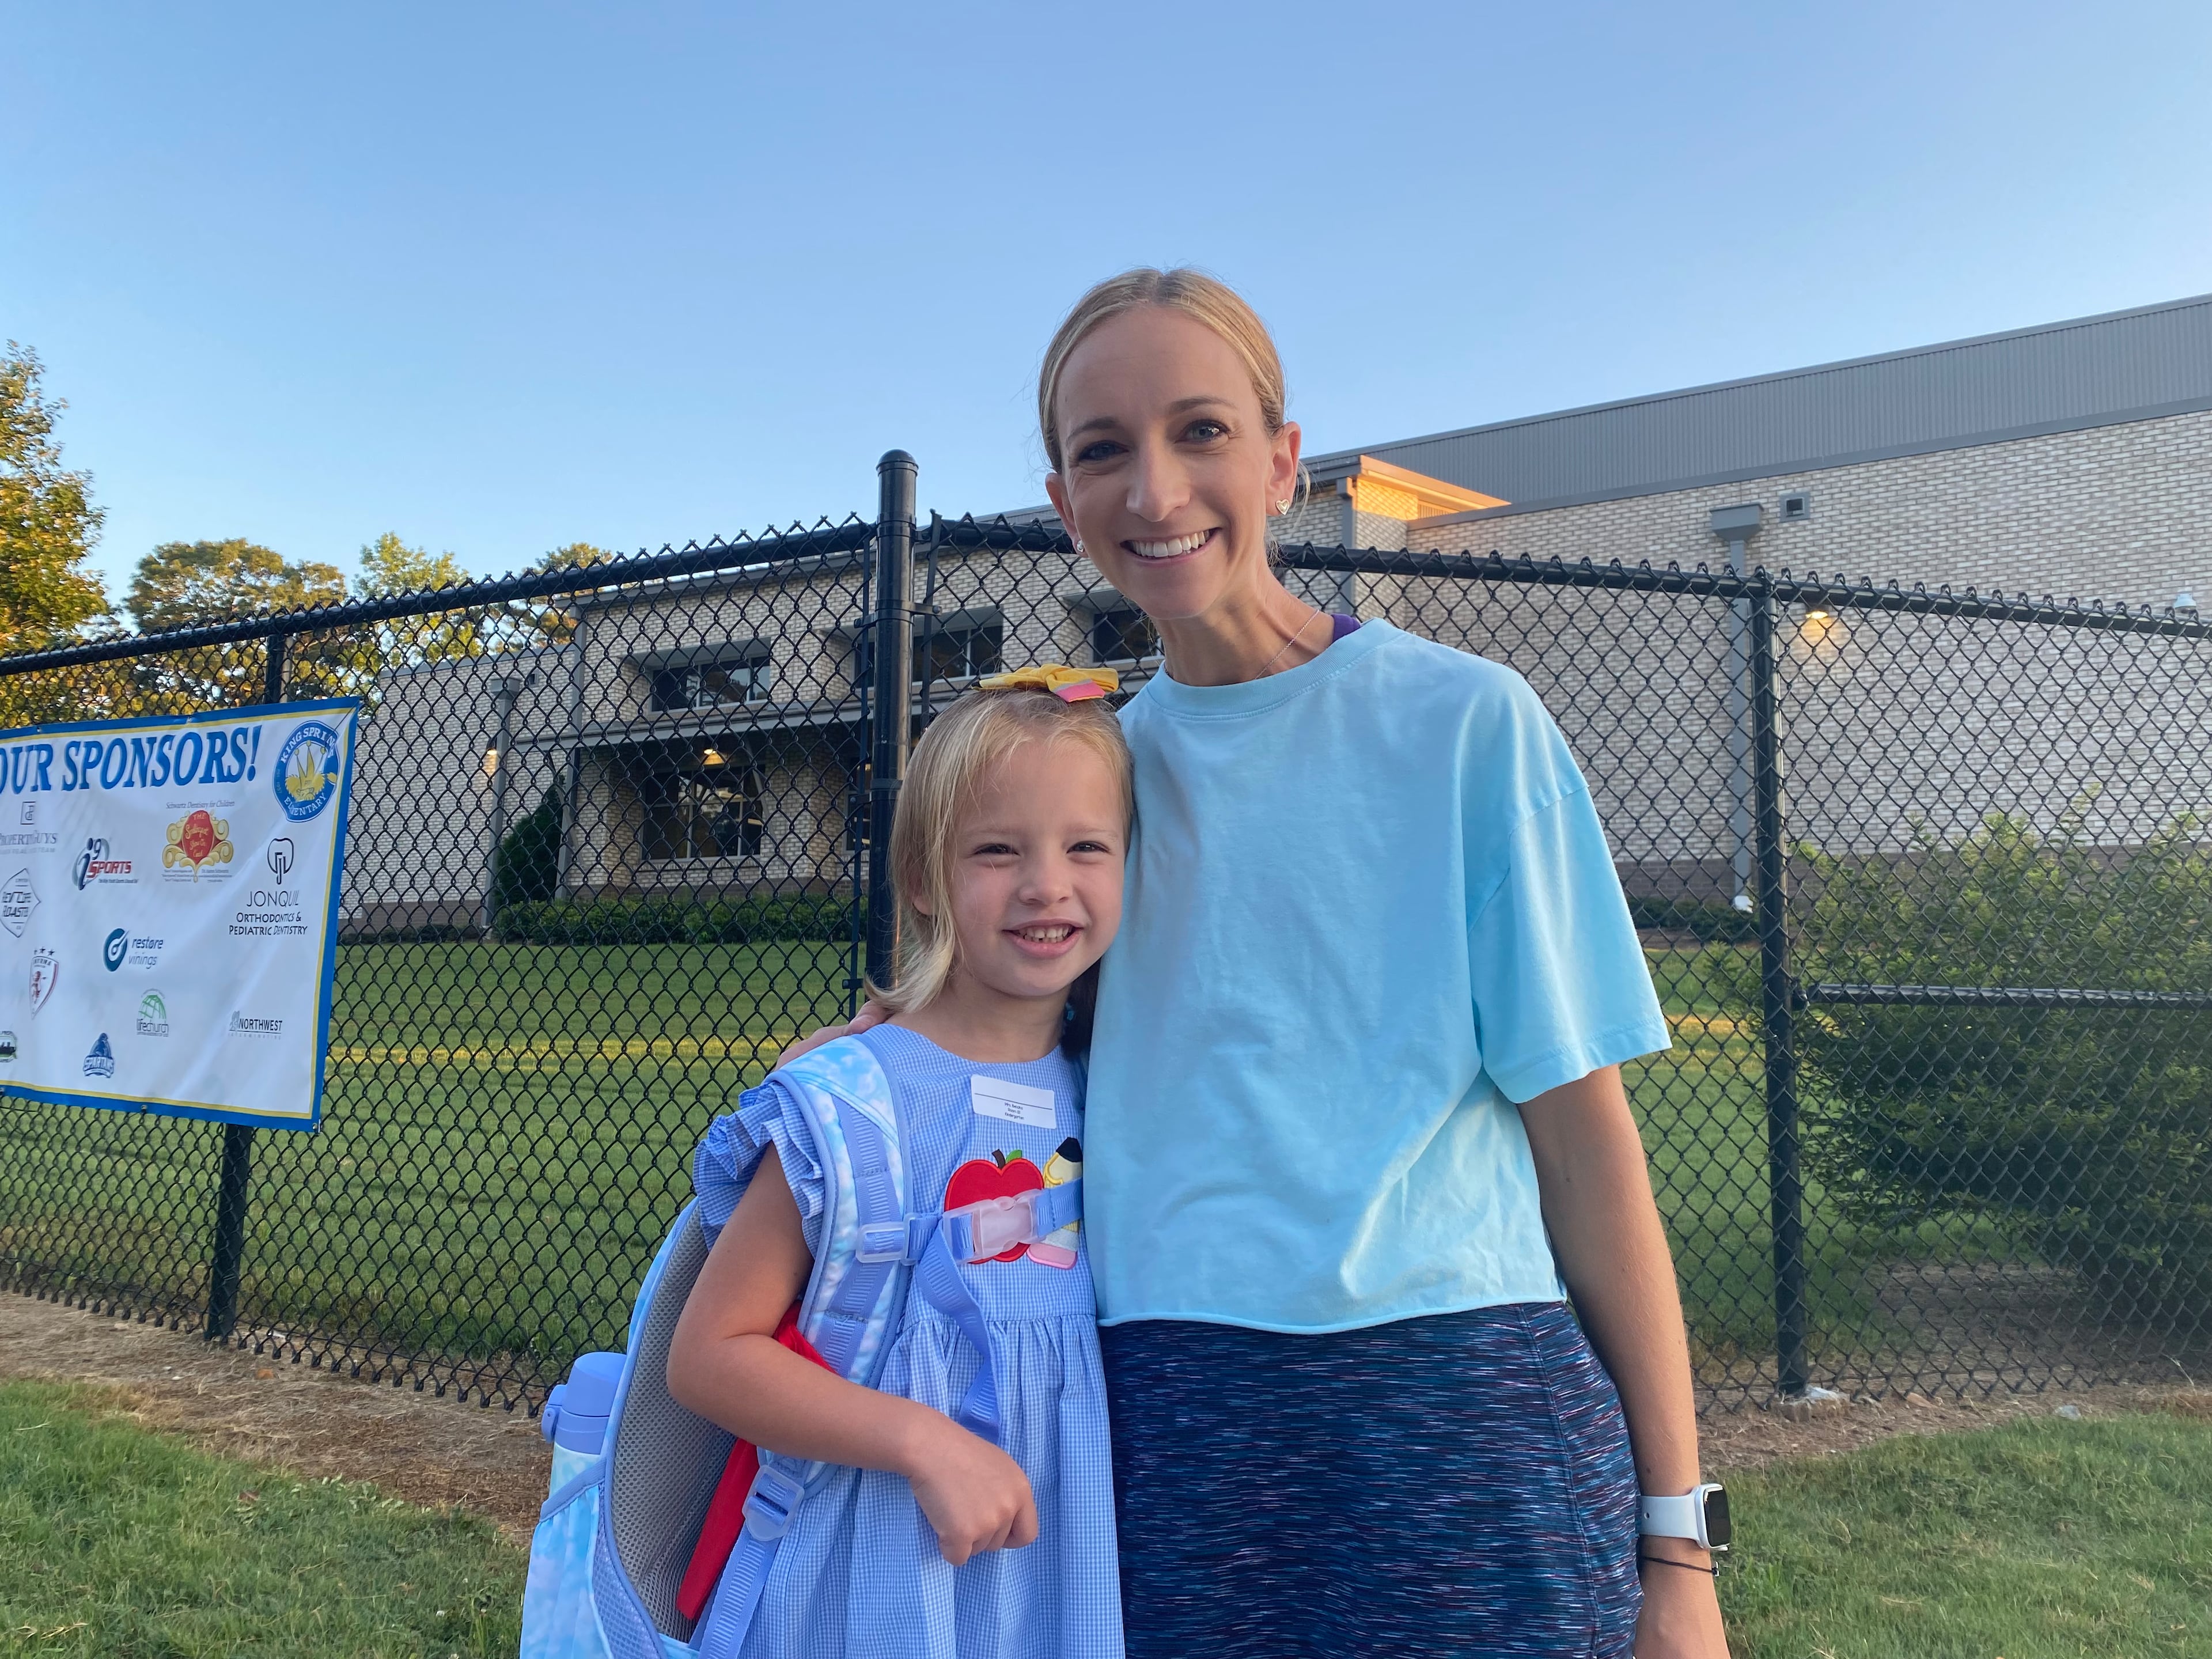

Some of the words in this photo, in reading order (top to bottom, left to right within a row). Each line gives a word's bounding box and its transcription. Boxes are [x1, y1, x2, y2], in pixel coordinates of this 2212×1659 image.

[281, 731, 302, 763] KING
[0, 743, 53, 794] UR
[61, 725, 262, 791] SPONSORS!
[86, 861, 131, 879] SPORTS
[247, 891, 299, 907] JONQUIL
[236, 912, 294, 922] ORTHODONTICS
[296, 911, 301, 922] &
[229, 925, 272, 935] PEDIATRIC
[274, 926, 308, 935] DENTISTRY
[129, 952, 157, 969] vinings
[239, 1018, 282, 1031] NORTHWEST
